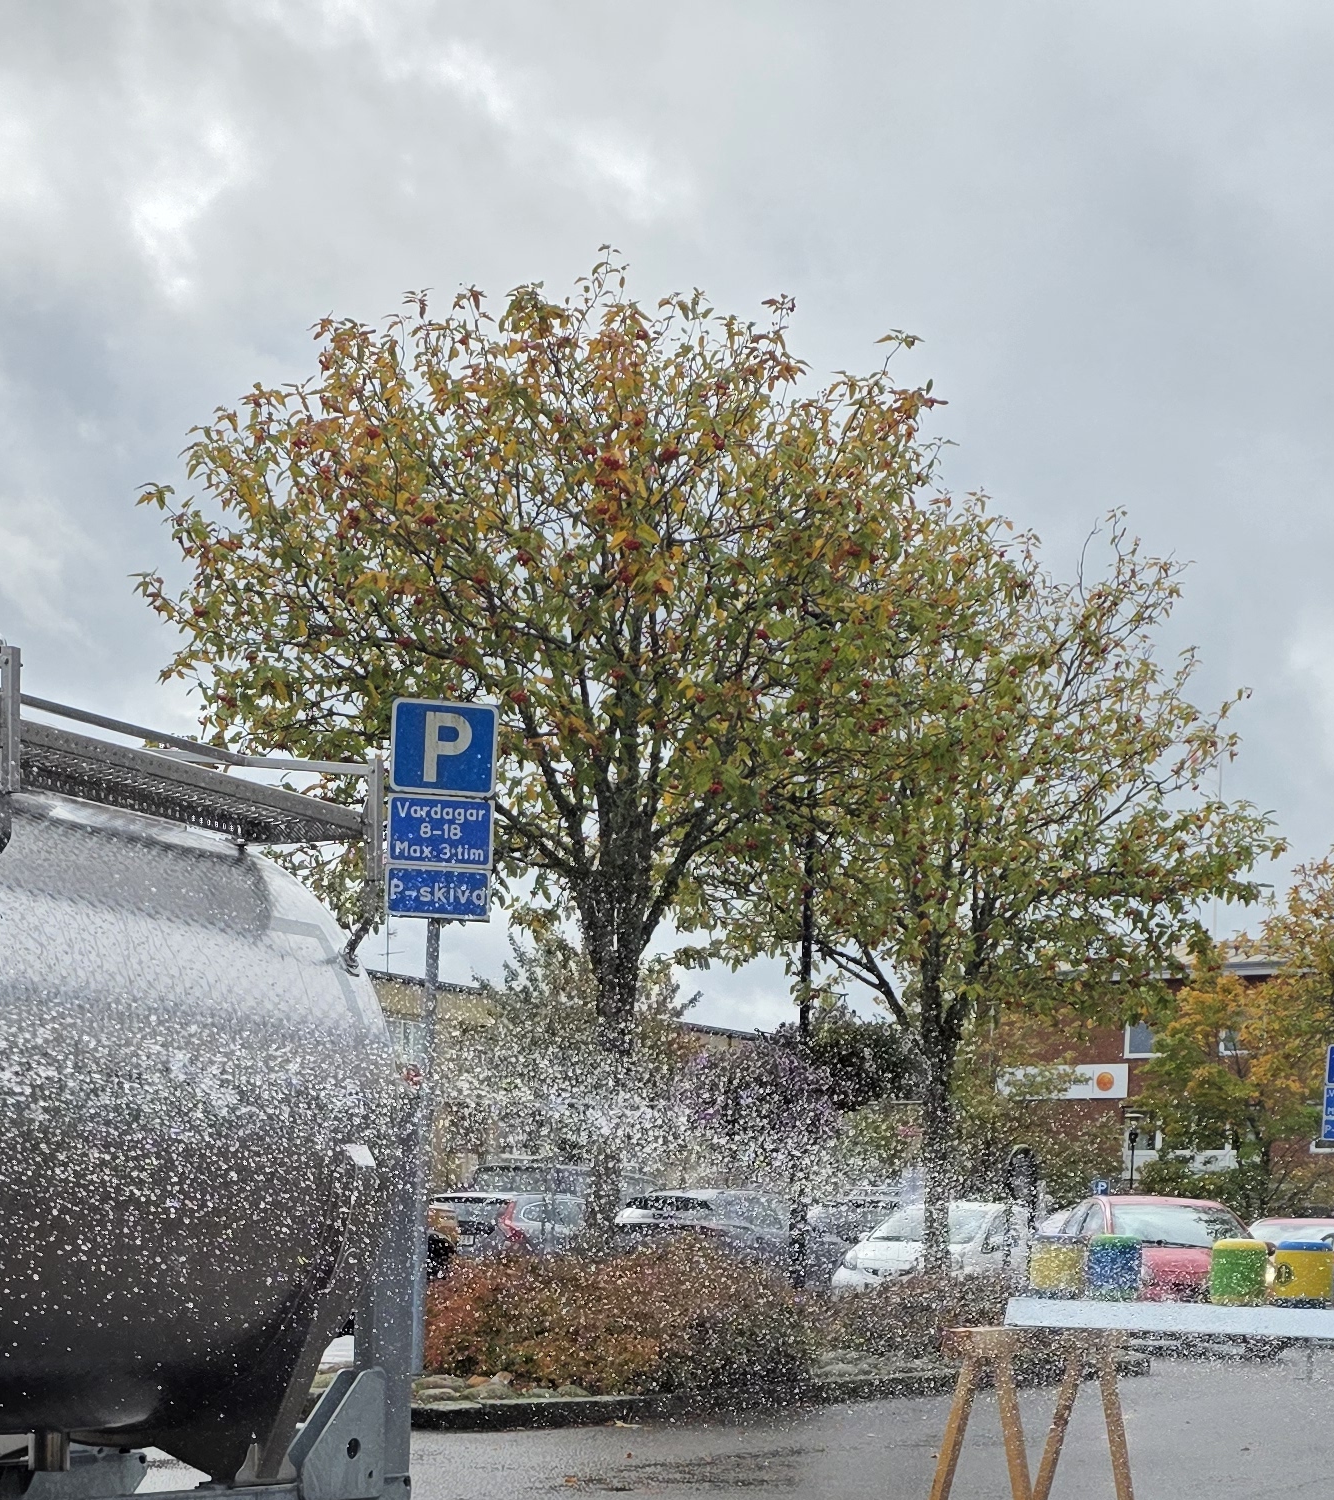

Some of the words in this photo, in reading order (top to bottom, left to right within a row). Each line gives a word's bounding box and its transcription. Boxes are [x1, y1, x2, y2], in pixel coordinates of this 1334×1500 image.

[422, 711, 473, 783] P
[396, 801, 486, 824] Vardagar
[419, 822, 462, 840] 8-18
[395, 840, 433, 858] Max
[438, 843, 451, 859] 3
[456, 844, 484, 862] tim
[389, 879, 487, 906] P-skiva
